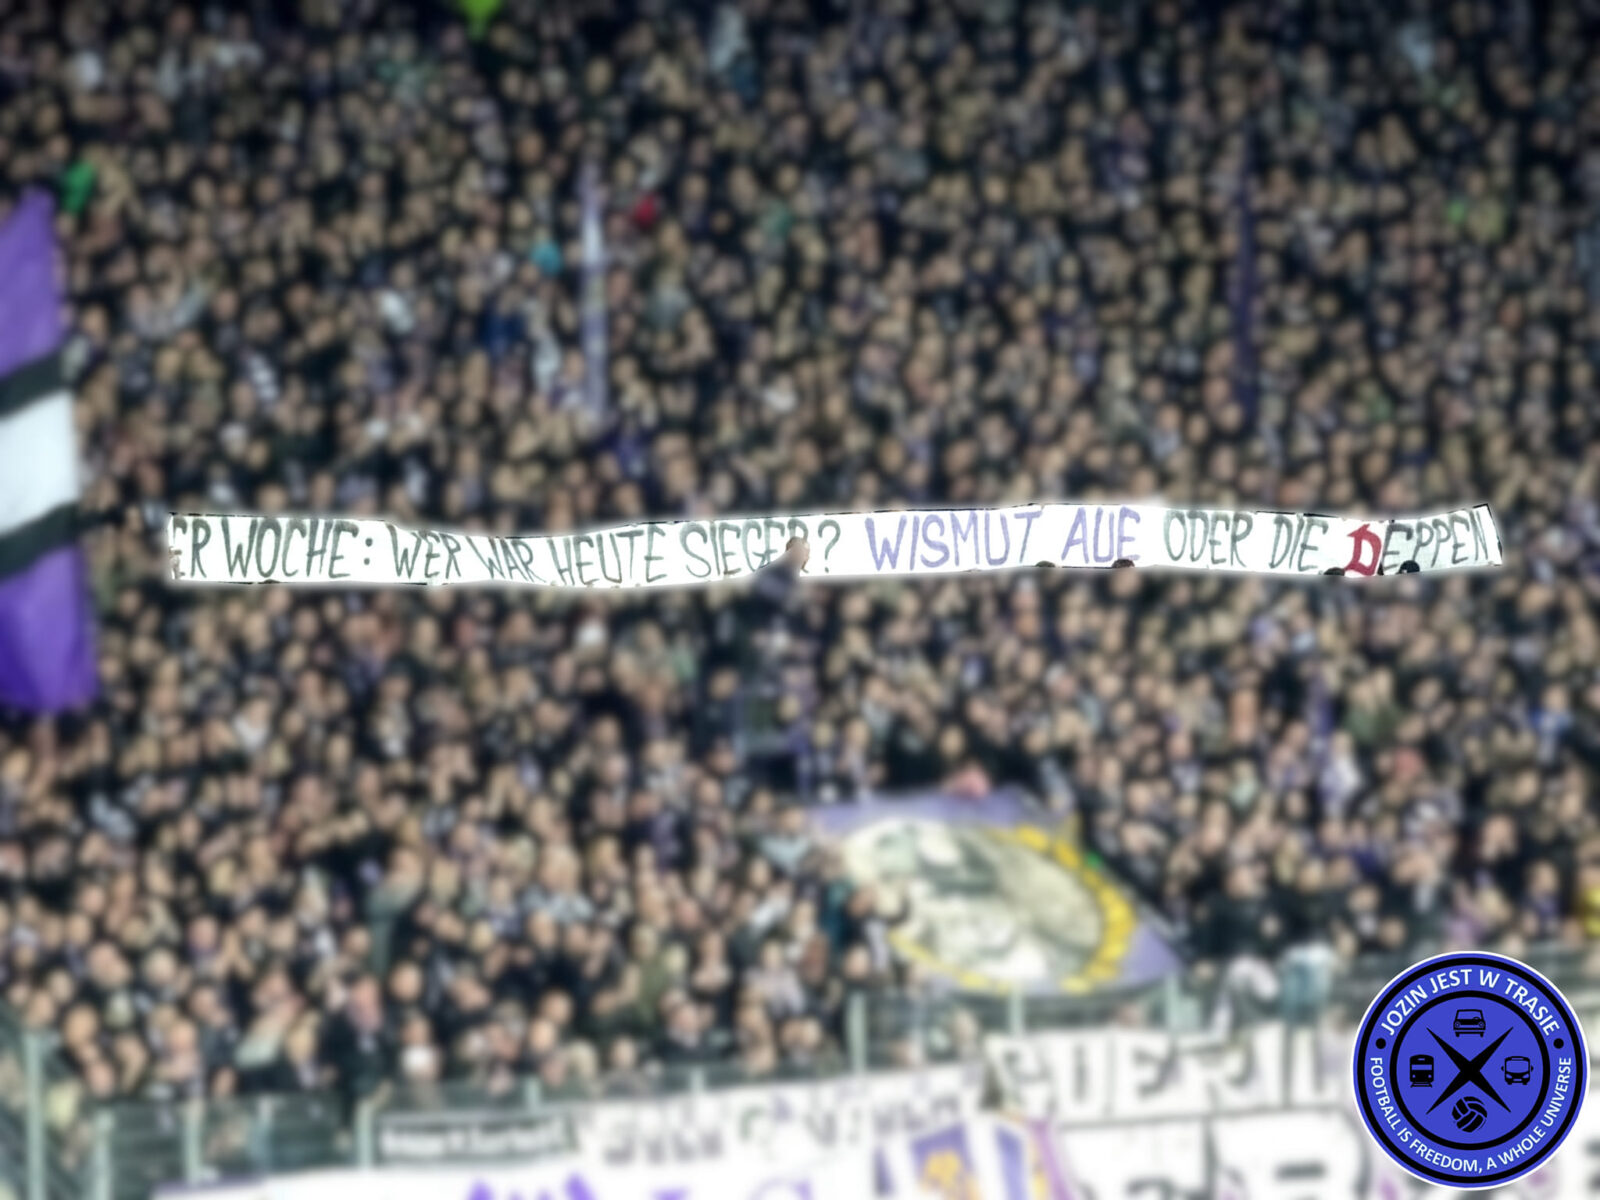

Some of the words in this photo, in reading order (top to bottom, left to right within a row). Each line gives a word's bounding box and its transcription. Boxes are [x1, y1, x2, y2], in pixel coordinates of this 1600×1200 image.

[221, 517, 375, 579] WOCHE:
[386, 523, 462, 579] WER
[466, 535, 545, 582] WAR
[547, 520, 668, 586] HEUTE
[864, 510, 1043, 571] WISMUT
[1061, 506, 1141, 564] AUE
[1163, 509, 1254, 568] ODER
[1269, 513, 1329, 572] DIE
[1343, 510, 1490, 577] DEPPEN
